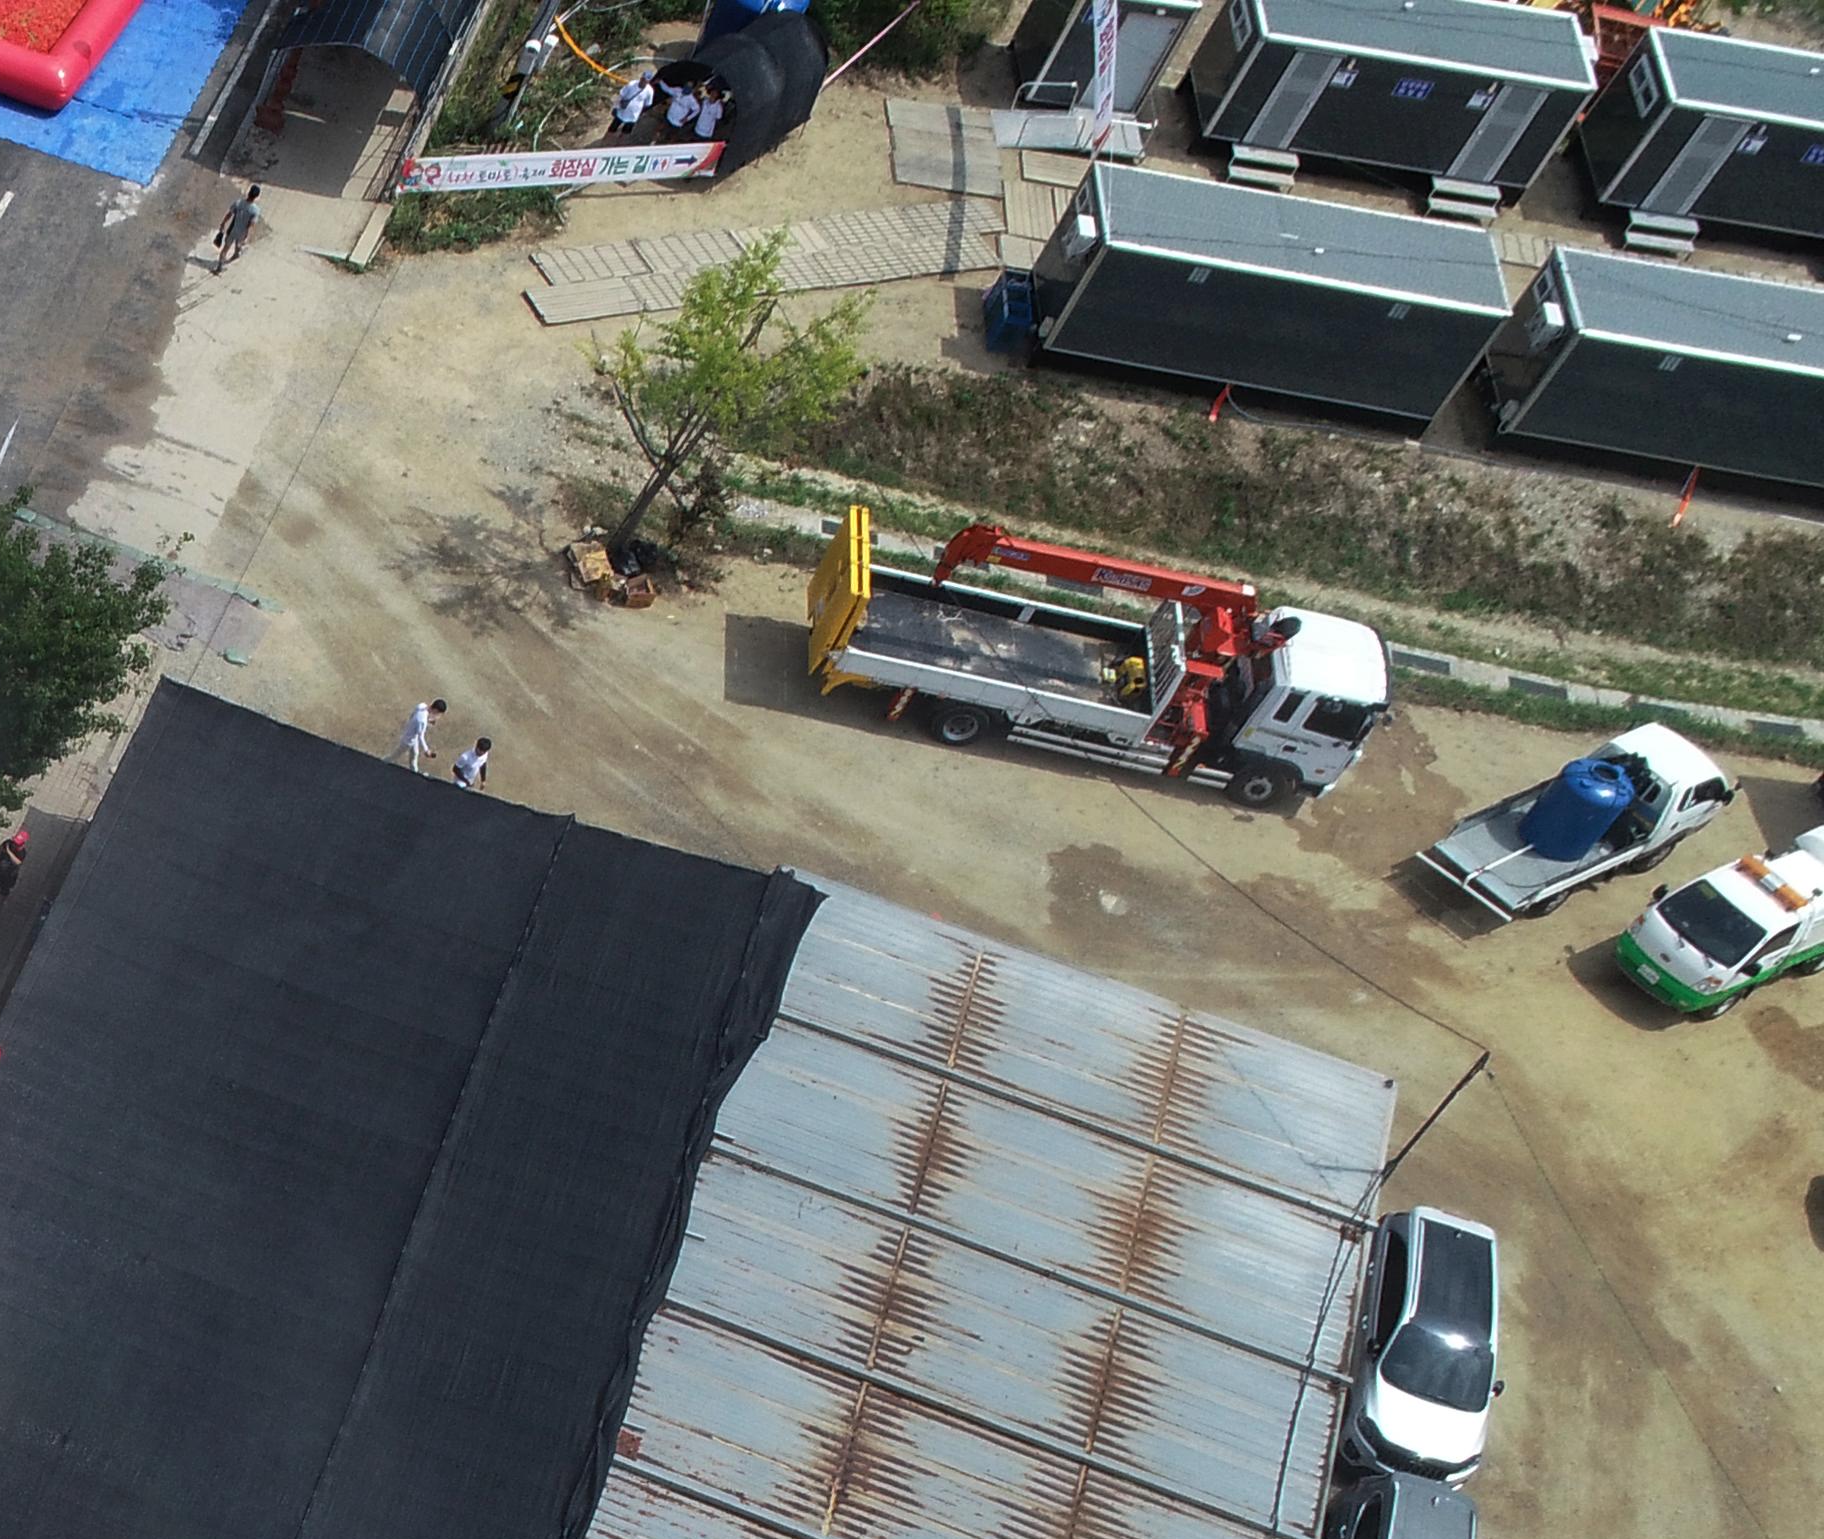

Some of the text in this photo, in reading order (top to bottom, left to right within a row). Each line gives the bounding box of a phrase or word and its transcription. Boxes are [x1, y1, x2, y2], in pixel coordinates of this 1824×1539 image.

[548, 158, 598, 178] 화장실
[599, 156, 631, 176] 가는
[632, 154, 651, 175] 길
